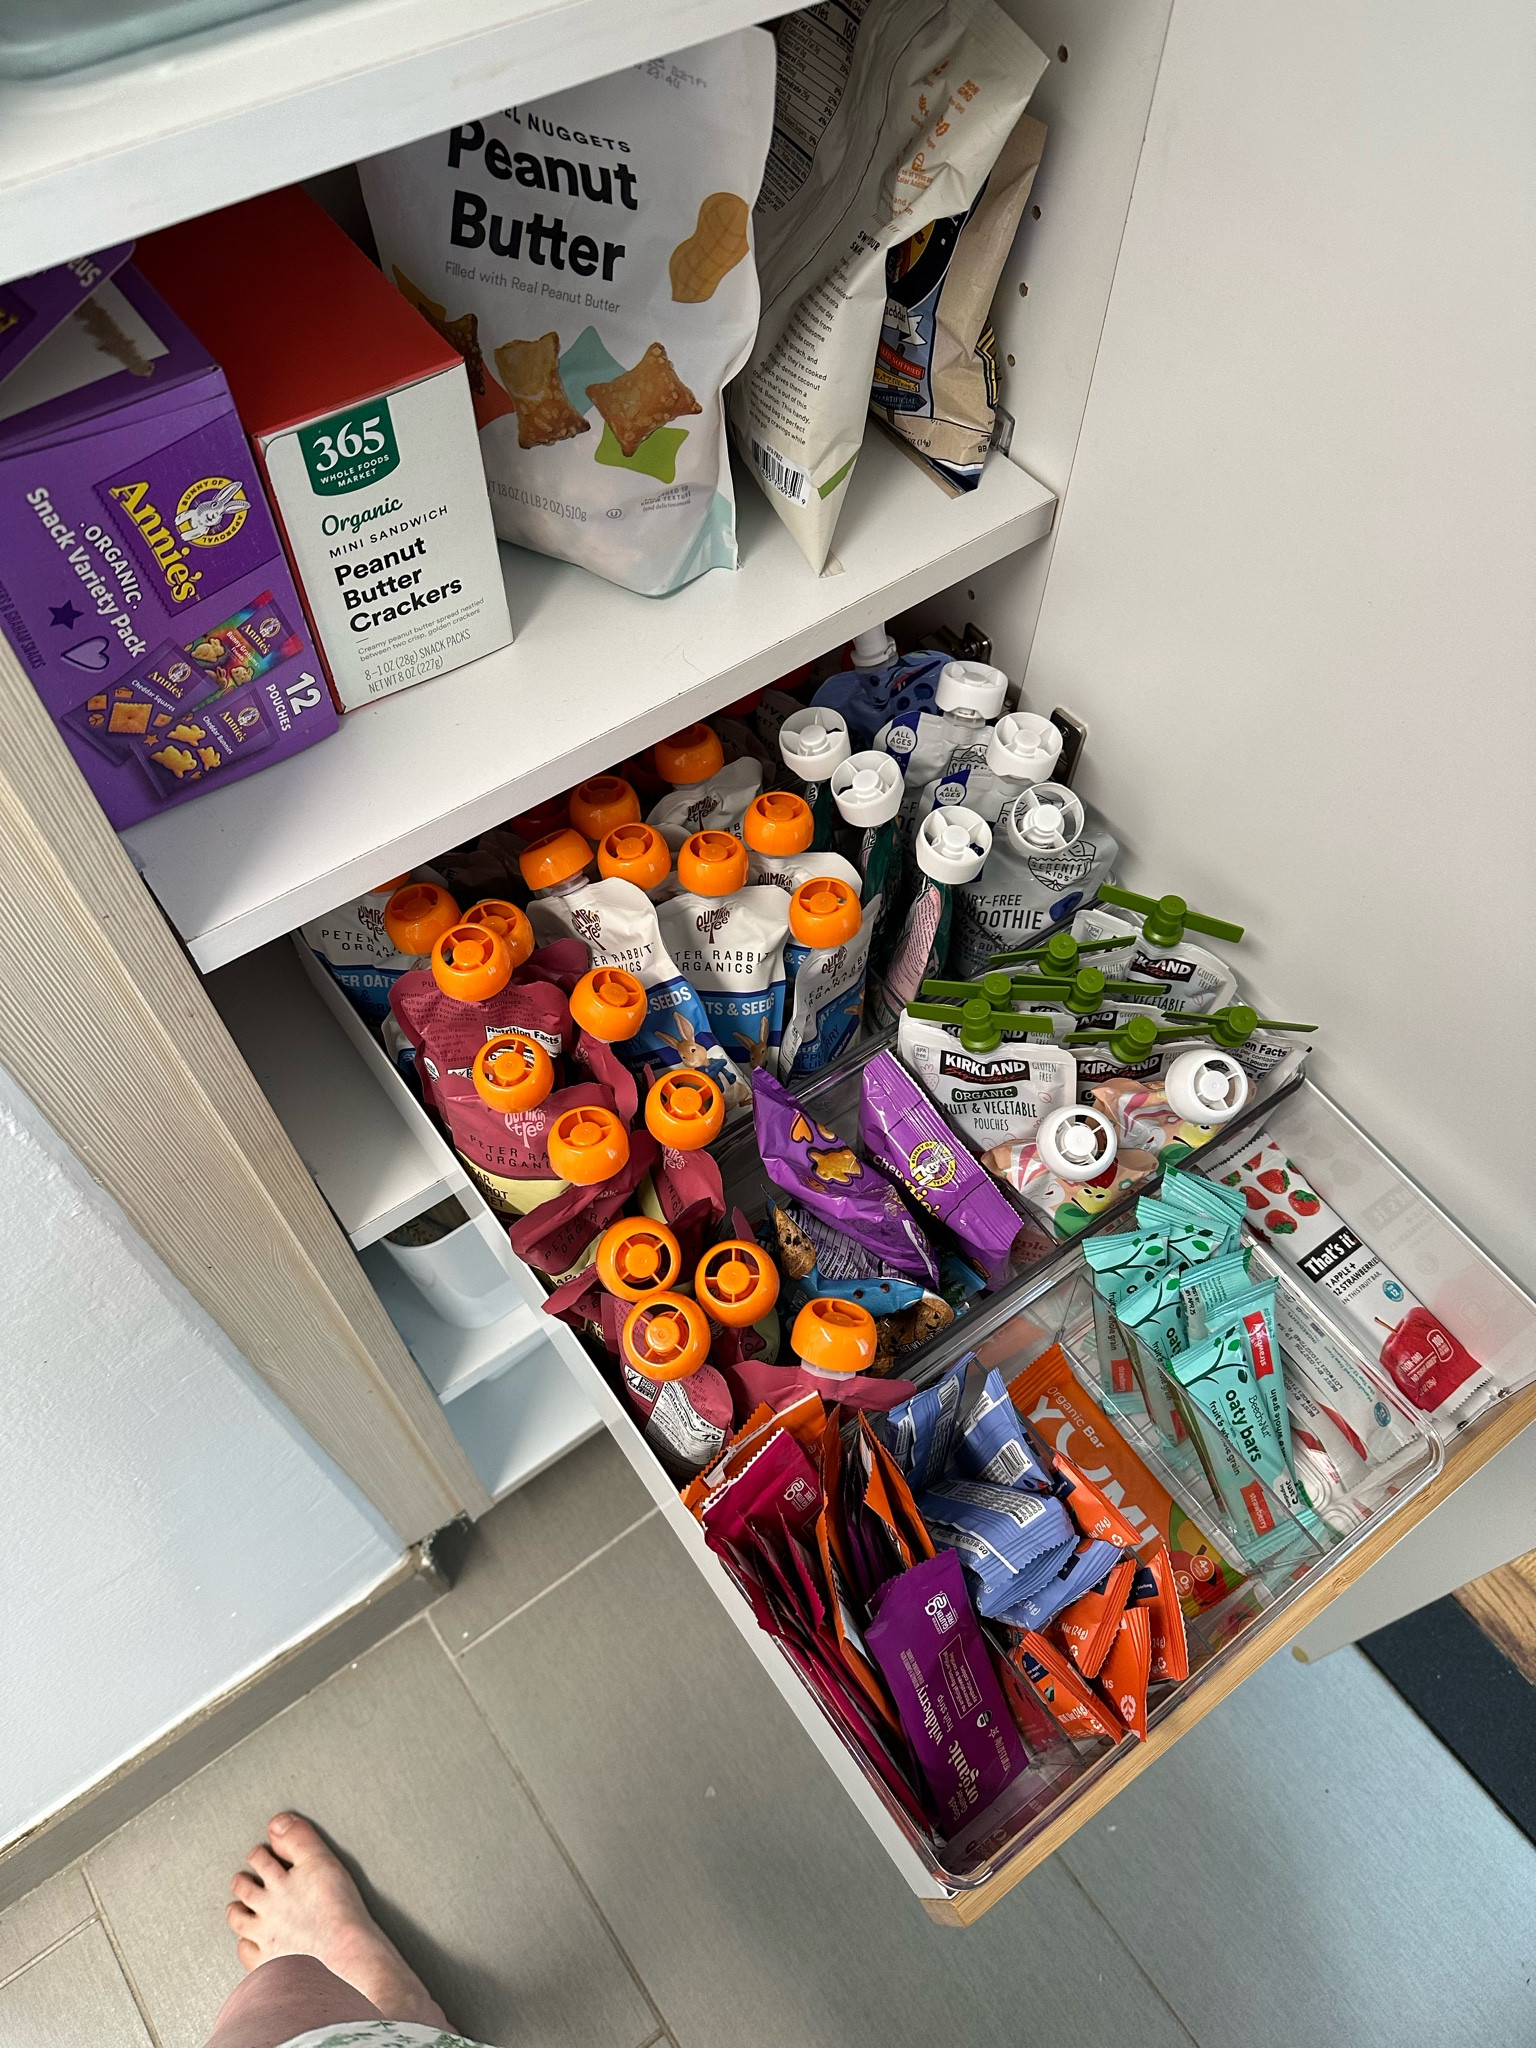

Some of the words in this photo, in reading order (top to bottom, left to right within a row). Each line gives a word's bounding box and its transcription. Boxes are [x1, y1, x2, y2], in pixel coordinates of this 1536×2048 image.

[843, 18, 857, 43] 160
[957, 86, 974, 102] GMO
[963, 79, 981, 96] NON
[528, 116, 631, 153] NUGGETS
[448, 119, 638, 210] Peanut
[450, 190, 625, 281] Butter
[445, 260, 476, 280] Filled
[479, 269, 507, 287] with
[511, 277, 538, 295] Real
[540, 283, 581, 305] Peanut
[585, 294, 621, 314] Butter
[819, 320, 832, 333] from
[788, 342, 807, 360] spinach,
[803, 338, 816, 352] corn,
[787, 354, 805, 371] they're
[804, 367, 827, 381] cooked
[903, 363, 921, 377] FRIED
[767, 381, 781, 394] that's
[775, 375, 789, 387] gives
[789, 382, 803, 395] them
[797, 376, 821, 392] coconut
[781, 401, 793, 414] This
[792, 410, 811, 425] handy,
[770, 419, 791, 436] cravings
[790, 433, 806, 446] while
[785, 419, 806, 434] perfect
[312, 416, 385, 472] 365
[320, 465, 356, 485] WHOLE
[357, 453, 390, 471] FOODS
[337, 467, 377, 489] MARKET
[181, 479, 210, 507] BUNNY
[211, 479, 225, 488] OF
[498, 482, 509, 497] 18
[508, 486, 521, 501] OZ
[530, 492, 542, 508] LB
[549, 499, 565, 519] OZ)
[565, 504, 588, 522] 510g
[321, 496, 404, 537] Organic
[202, 514, 245, 545] APPROVAL
[329, 537, 365, 559] MINI
[369, 504, 449, 544] SANDWICH
[109, 480, 204, 605] Annie's
[26, 487, 76, 552] Snack
[67, 546, 119, 616] Variety
[110, 613, 147, 659] Pack
[84, 525, 143, 603] ORGANIC
[334, 536, 427, 587] Peanut
[342, 566, 423, 611] Butter
[349, 578, 464, 633] Crackers
[358, 641, 387, 655] Creamy
[388, 630, 414, 644] peanut
[413, 621, 436, 634] butter
[436, 610, 460, 624] spread
[460, 597, 485, 613] nestled
[359, 647, 392, 662] between
[392, 641, 407, 649] two
[407, 632, 428, 644] crisp,
[428, 620, 452, 637] golden
[452, 608, 481, 625] crackers
[4, 610, 33, 644] GRAHAM
[20, 641, 47, 670] SNACKS
[226, 631, 242, 649] Bunny
[239, 644, 259, 668] Grahams
[383, 660, 396, 673] OZ
[395, 651, 419, 670] (28g)
[418, 639, 446, 659] SNACK
[445, 628, 471, 648] PACKS
[368, 679, 385, 694] NET
[383, 673, 398, 688] WT
[397, 671, 405, 682] 8
[404, 666, 417, 680] OZ
[416, 654, 444, 676] (227g)
[131, 678, 157, 699] Cheddar
[154, 693, 177, 713] Squares
[286, 672, 322, 716] 12
[265, 683, 292, 733] POUCHES
[202, 715, 221, 740] Cheddar
[217, 736, 234, 755] Bunnies
[889, 737, 912, 747] AGES
[894, 730, 910, 740] ALL
[938, 791, 961, 799] AGES
[1031, 860, 1089, 877] SERENITY
[1045, 869, 1070, 882] KIDS
[964, 901, 1045, 930] MOOTHIE
[611, 943, 654, 963] RABBIT
[713, 949, 772, 963] RABBIT
[1100, 963, 1125, 975] GLUTEN
[1196, 968, 1220, 985] GLUTEN
[1197, 979, 1212, 991] FREE
[650, 985, 692, 1011] SEEDS
[726, 1003, 739, 1016] &
[741, 992, 775, 1016] SEEDS
[1132, 993, 1186, 1013] VEGETABLE
[487, 1026, 531, 1039] Nutrition
[534, 1031, 560, 1045] Facts
[1258, 1044, 1288, 1058] Facts
[945, 1053, 1027, 1078] KIRKLAND
[1031, 1062, 1058, 1073] GLUTEN
[1038, 1072, 1054, 1083] FREE
[954, 1087, 1014, 1100] ORGANIC
[971, 1103, 982, 1114] &
[984, 1100, 1038, 1118] VEGETABLE
[973, 1117, 1010, 1131] POUCHES
[469, 1134, 519, 1157] PETER
[485, 1153, 551, 1169] ORGANI
[1303, 1239, 1346, 1276] That's
[1330, 1266, 1351, 1286] APPLE
[1332, 1285, 1342, 1297] 12
[1349, 1287, 1361, 1299] THIS
[1359, 1278, 1373, 1291] FRUIT
[1108, 1329, 1117, 1351] grain
[1431, 1333, 1445, 1348] 100
[1400, 1351, 1424, 1374] NON-GMO
[1117, 1364, 1127, 1393] strawberry
[1324, 1377, 1339, 1393] BEST
[1270, 1388, 1281, 1412] grain
[1046, 1385, 1086, 1428] Organic
[1082, 1426, 1106, 1449] Bar
[1225, 1388, 1249, 1426] oaty
[1239, 1425, 1263, 1463] bars
[1273, 1411, 1285, 1442] whole
[1208, 1400, 1221, 1422] fruit
[1225, 1452, 1241, 1477] grain
[1285, 1479, 1295, 1497] Just
[1248, 1492, 1268, 1531] strawberry
[1094, 1515, 1112, 1537] (24g)
[1198, 1559, 1212, 1575] 4g
[1070, 1625, 1089, 1641] (24g)
[916, 1684, 945, 1746] wildberry
[937, 1694, 952, 1715] strip
[942, 1712, 955, 1734] fruit
[948, 1739, 980, 1805] organic
[955, 1784, 969, 1815] Gather
